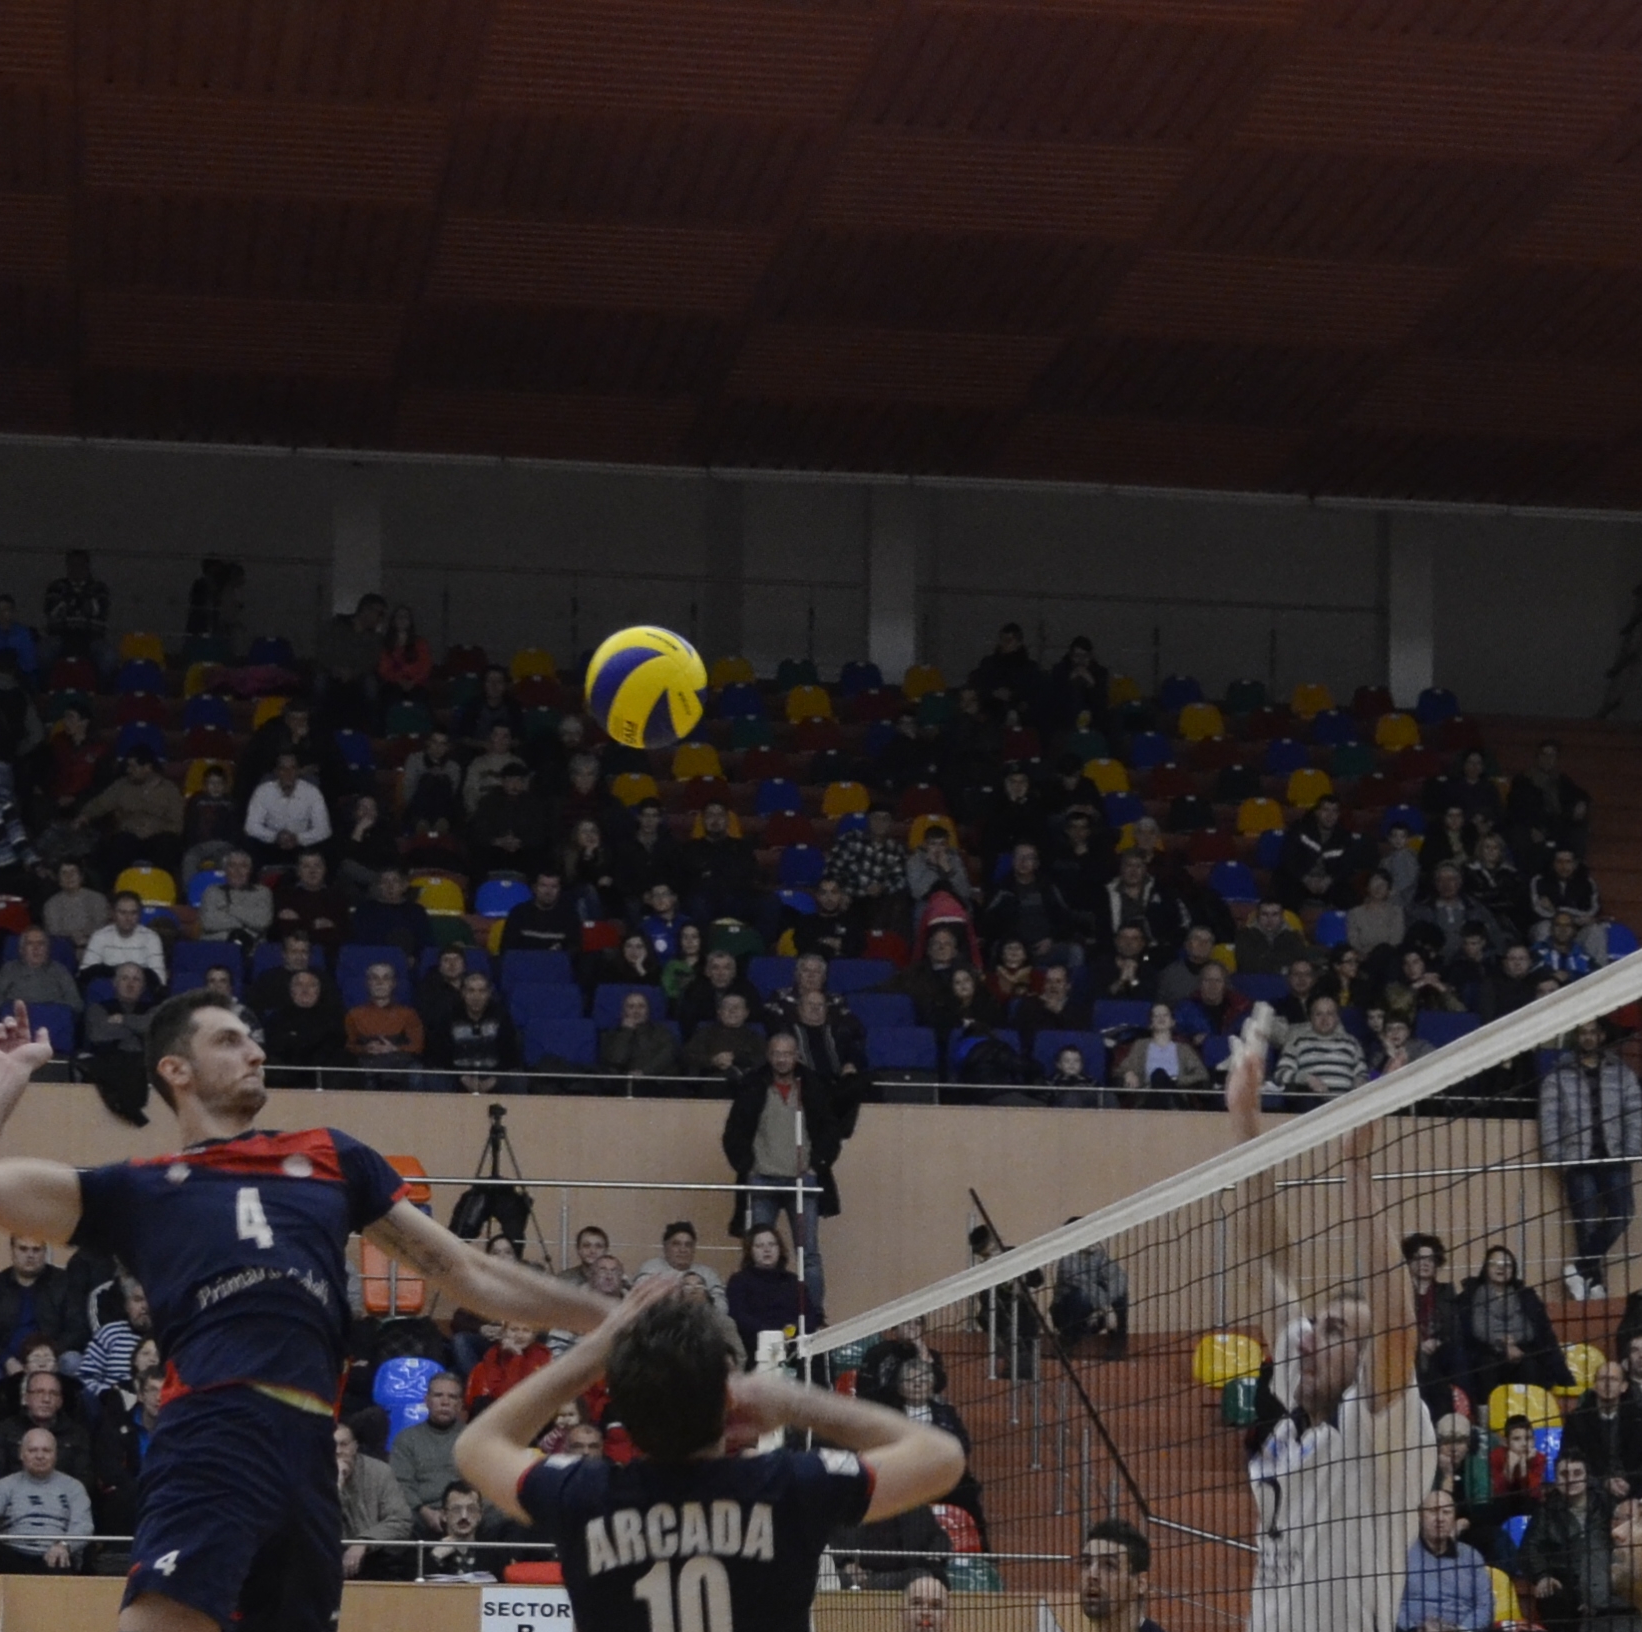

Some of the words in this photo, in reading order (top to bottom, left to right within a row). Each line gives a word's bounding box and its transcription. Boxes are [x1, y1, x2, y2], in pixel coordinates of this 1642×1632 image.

[235, 1186, 275, 1250] 4
[584, 1499, 776, 1578] ARCADA
[152, 1549, 181, 1577] 4
[483, 1601, 571, 1618] SECTOR
